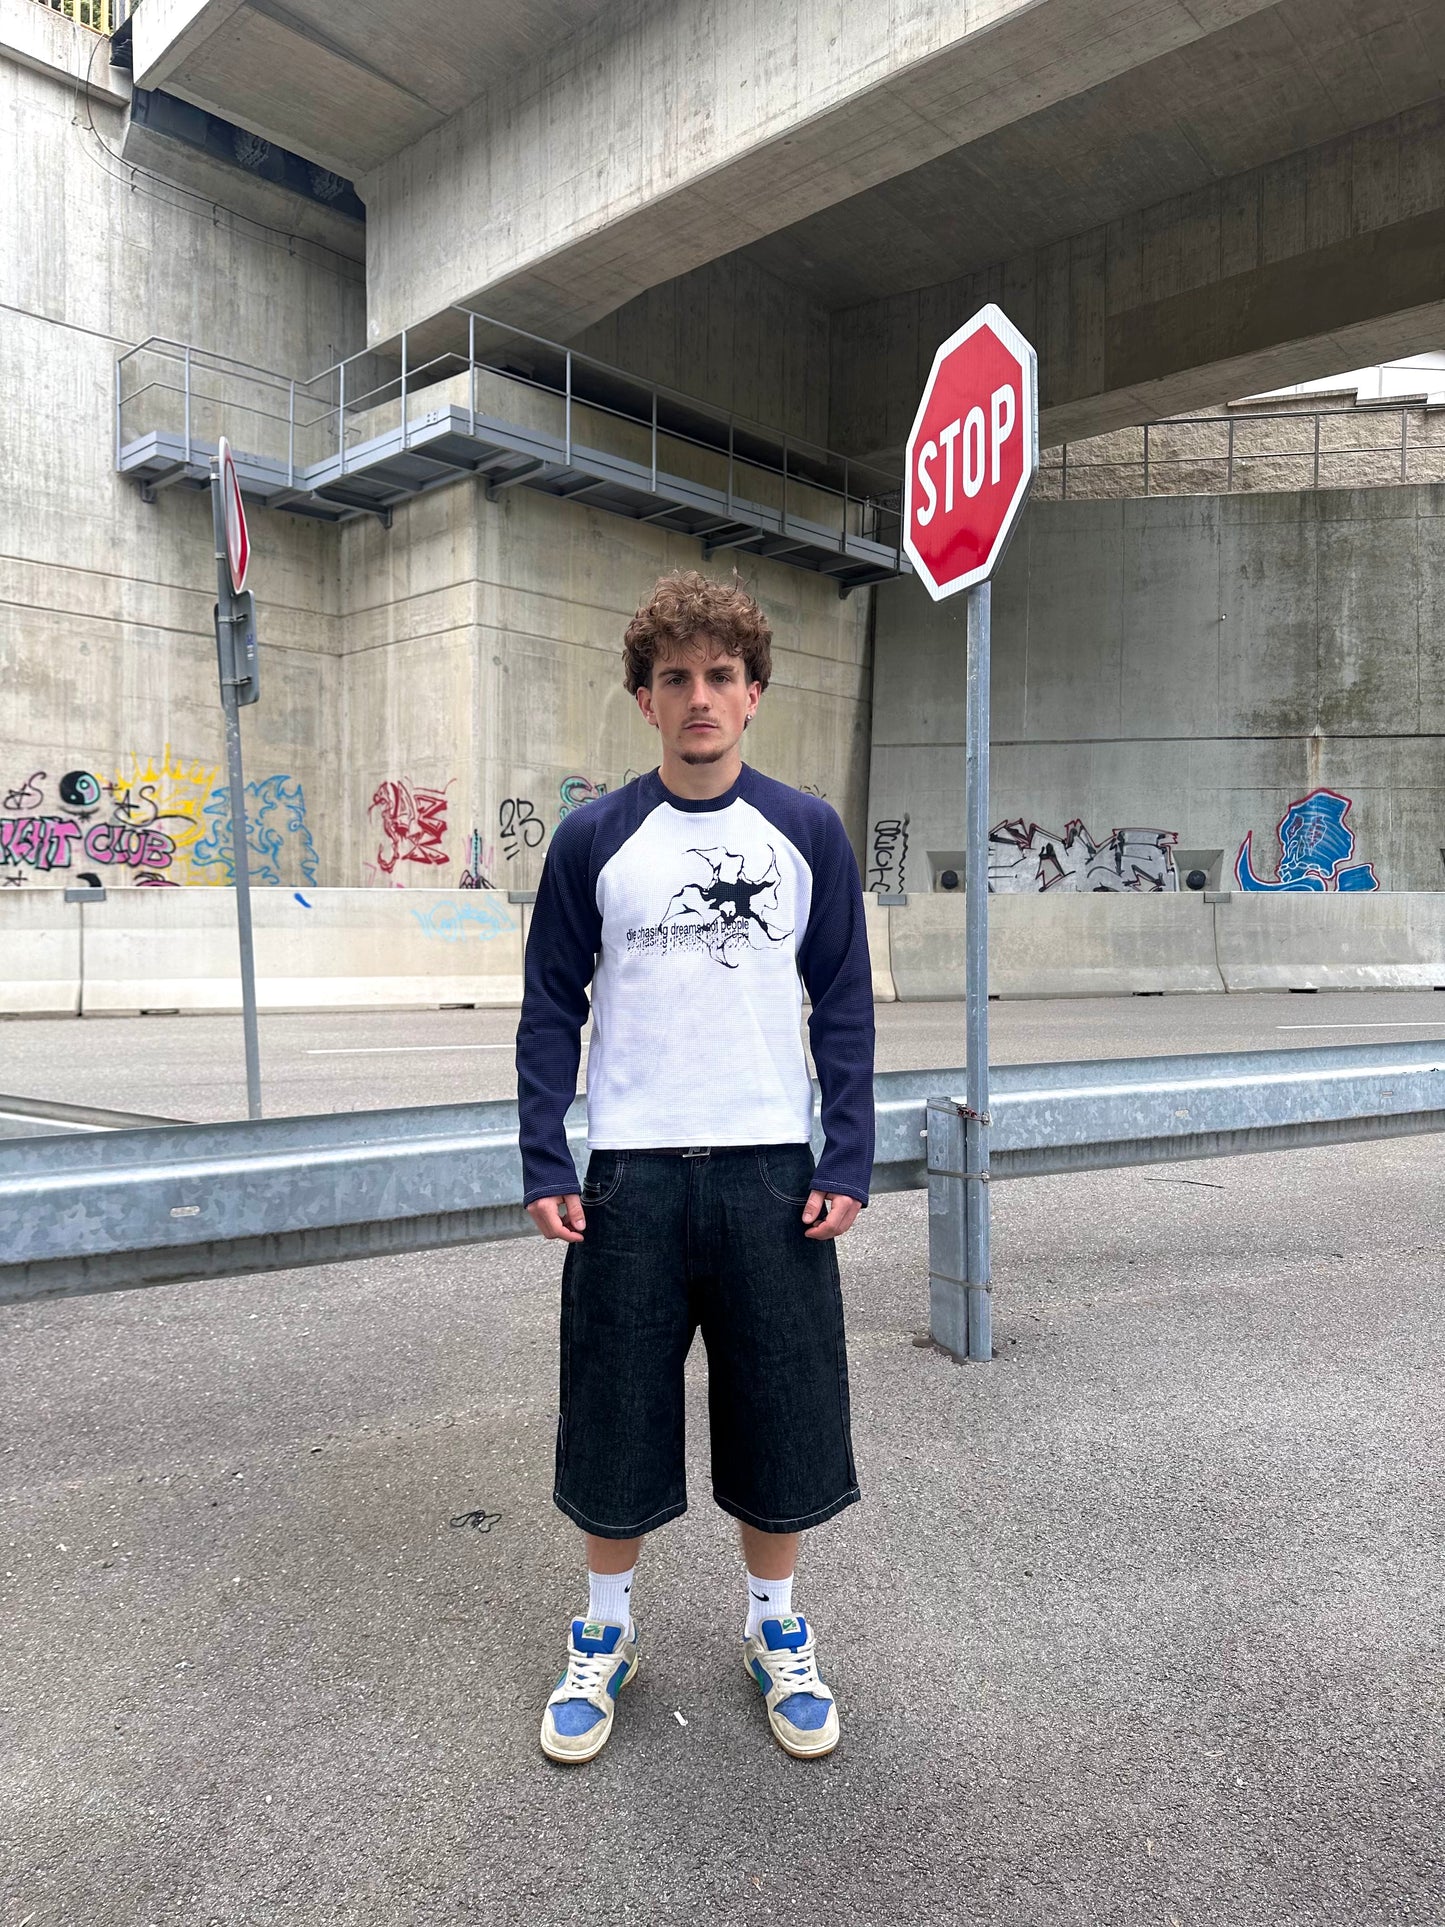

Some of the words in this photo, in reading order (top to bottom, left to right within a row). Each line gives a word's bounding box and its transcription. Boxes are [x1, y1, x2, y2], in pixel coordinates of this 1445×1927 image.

[916, 383, 1016, 526] STOP
[84, 822, 176, 869] CLUB
[499, 797, 545, 848] 23
[721, 916, 749, 934] people
